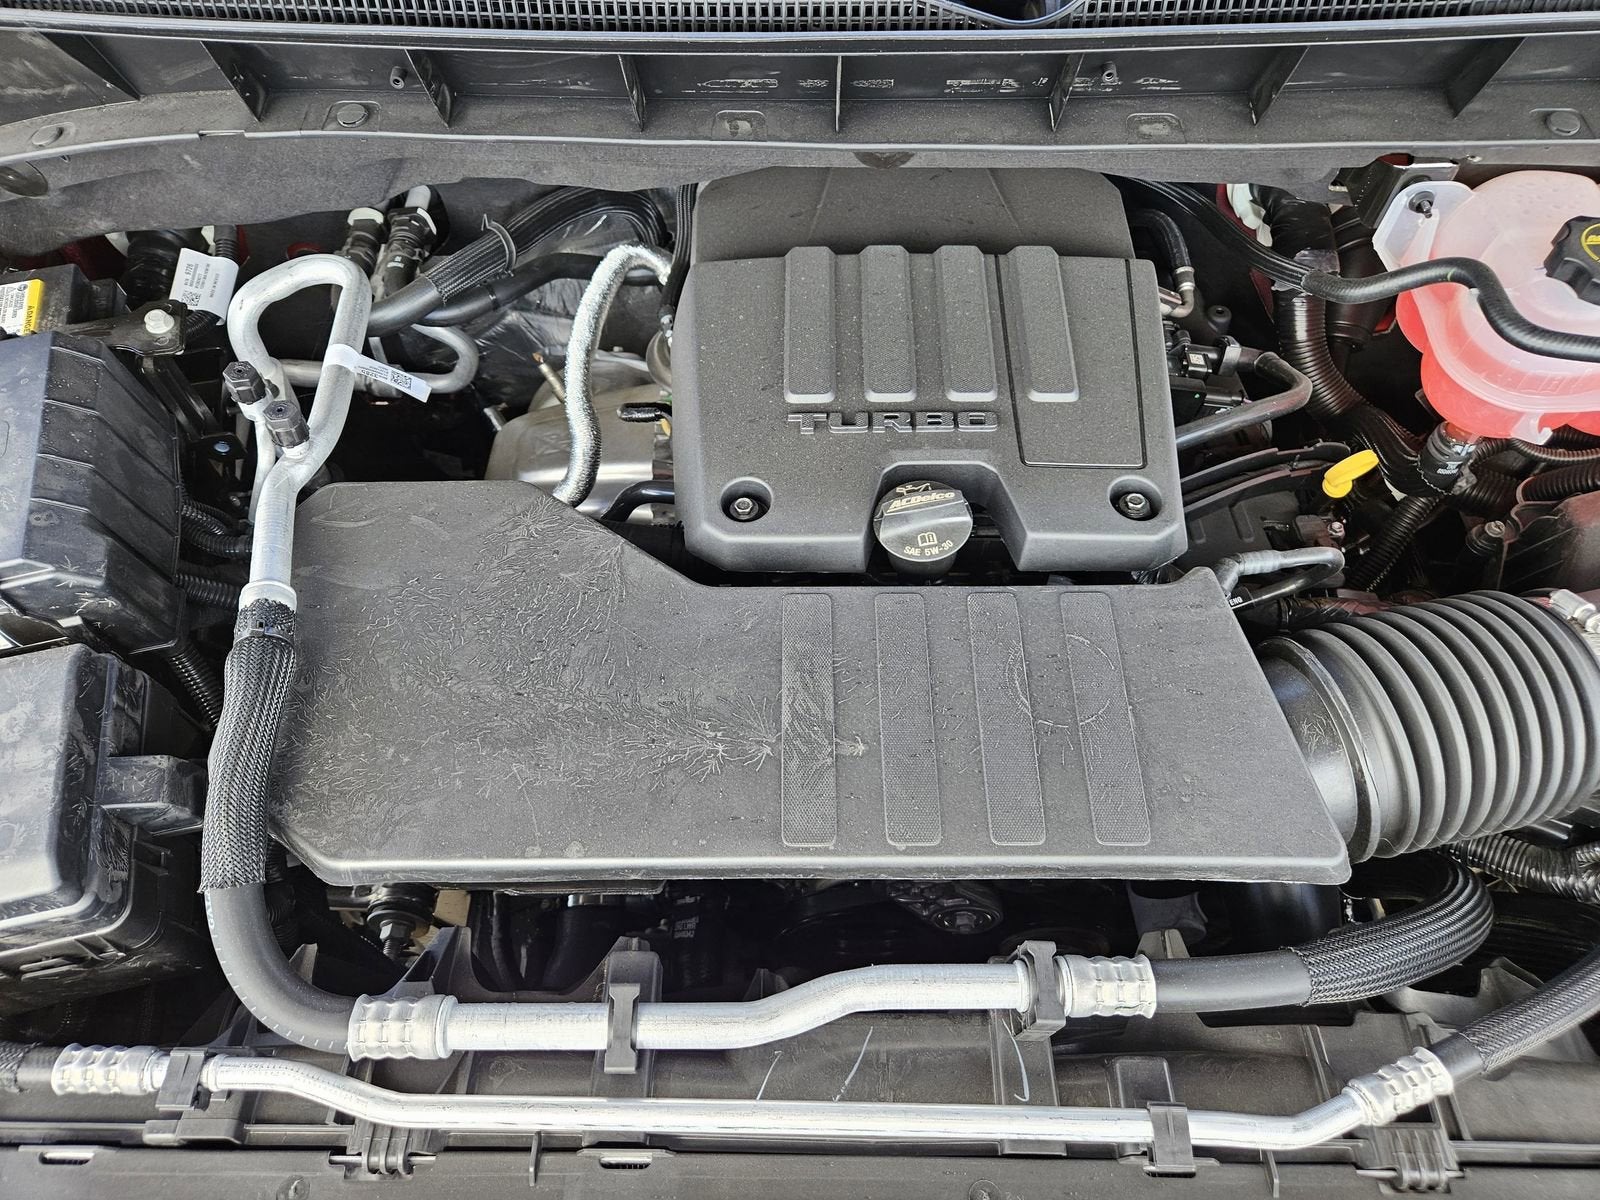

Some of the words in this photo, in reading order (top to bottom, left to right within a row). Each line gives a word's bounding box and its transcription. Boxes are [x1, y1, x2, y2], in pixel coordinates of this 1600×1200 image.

[23, 310, 34, 333] DANGE
[787, 411, 998, 435] TURBO
[887, 492, 956, 511] ACDelco
[903, 546, 922, 556] SAE
[924, 540, 954, 556] 5W-30
